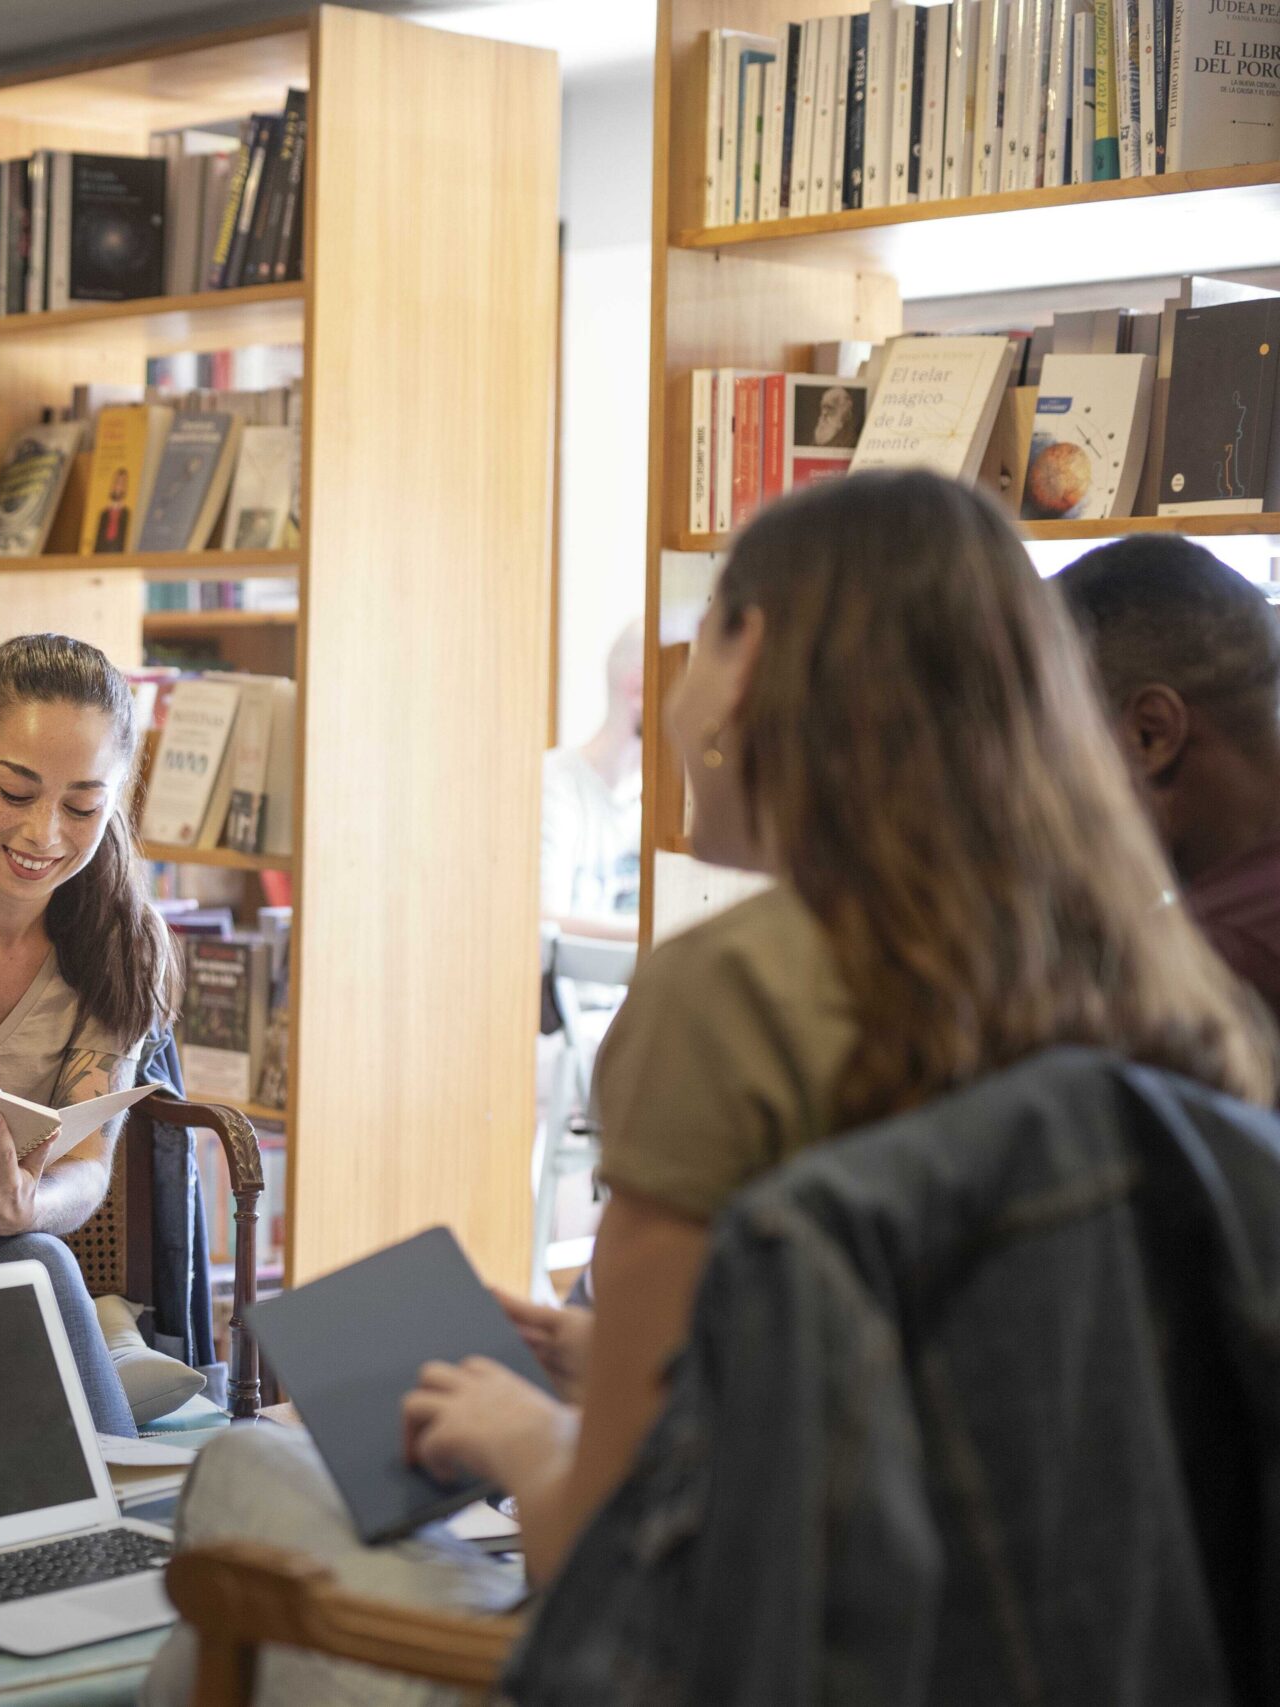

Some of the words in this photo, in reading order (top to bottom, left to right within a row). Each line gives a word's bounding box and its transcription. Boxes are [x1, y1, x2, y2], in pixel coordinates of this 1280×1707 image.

[1208, 0, 1255, 14] JUDEA
[1214, 40, 1236, 57] EL
[1172, 47, 1180, 70] DEL
[1194, 57, 1231, 74] DEL
[855, 47, 866, 88] TESLA
[1170, 73, 1179, 110] LIBRO
[1169, 113, 1177, 128] EL
[890, 367, 909, 383] El
[912, 366, 952, 383] telar
[883, 391, 944, 407] mágico
[874, 411, 894, 428] de
[898, 412, 913, 427] la
[866, 436, 920, 450] mente
